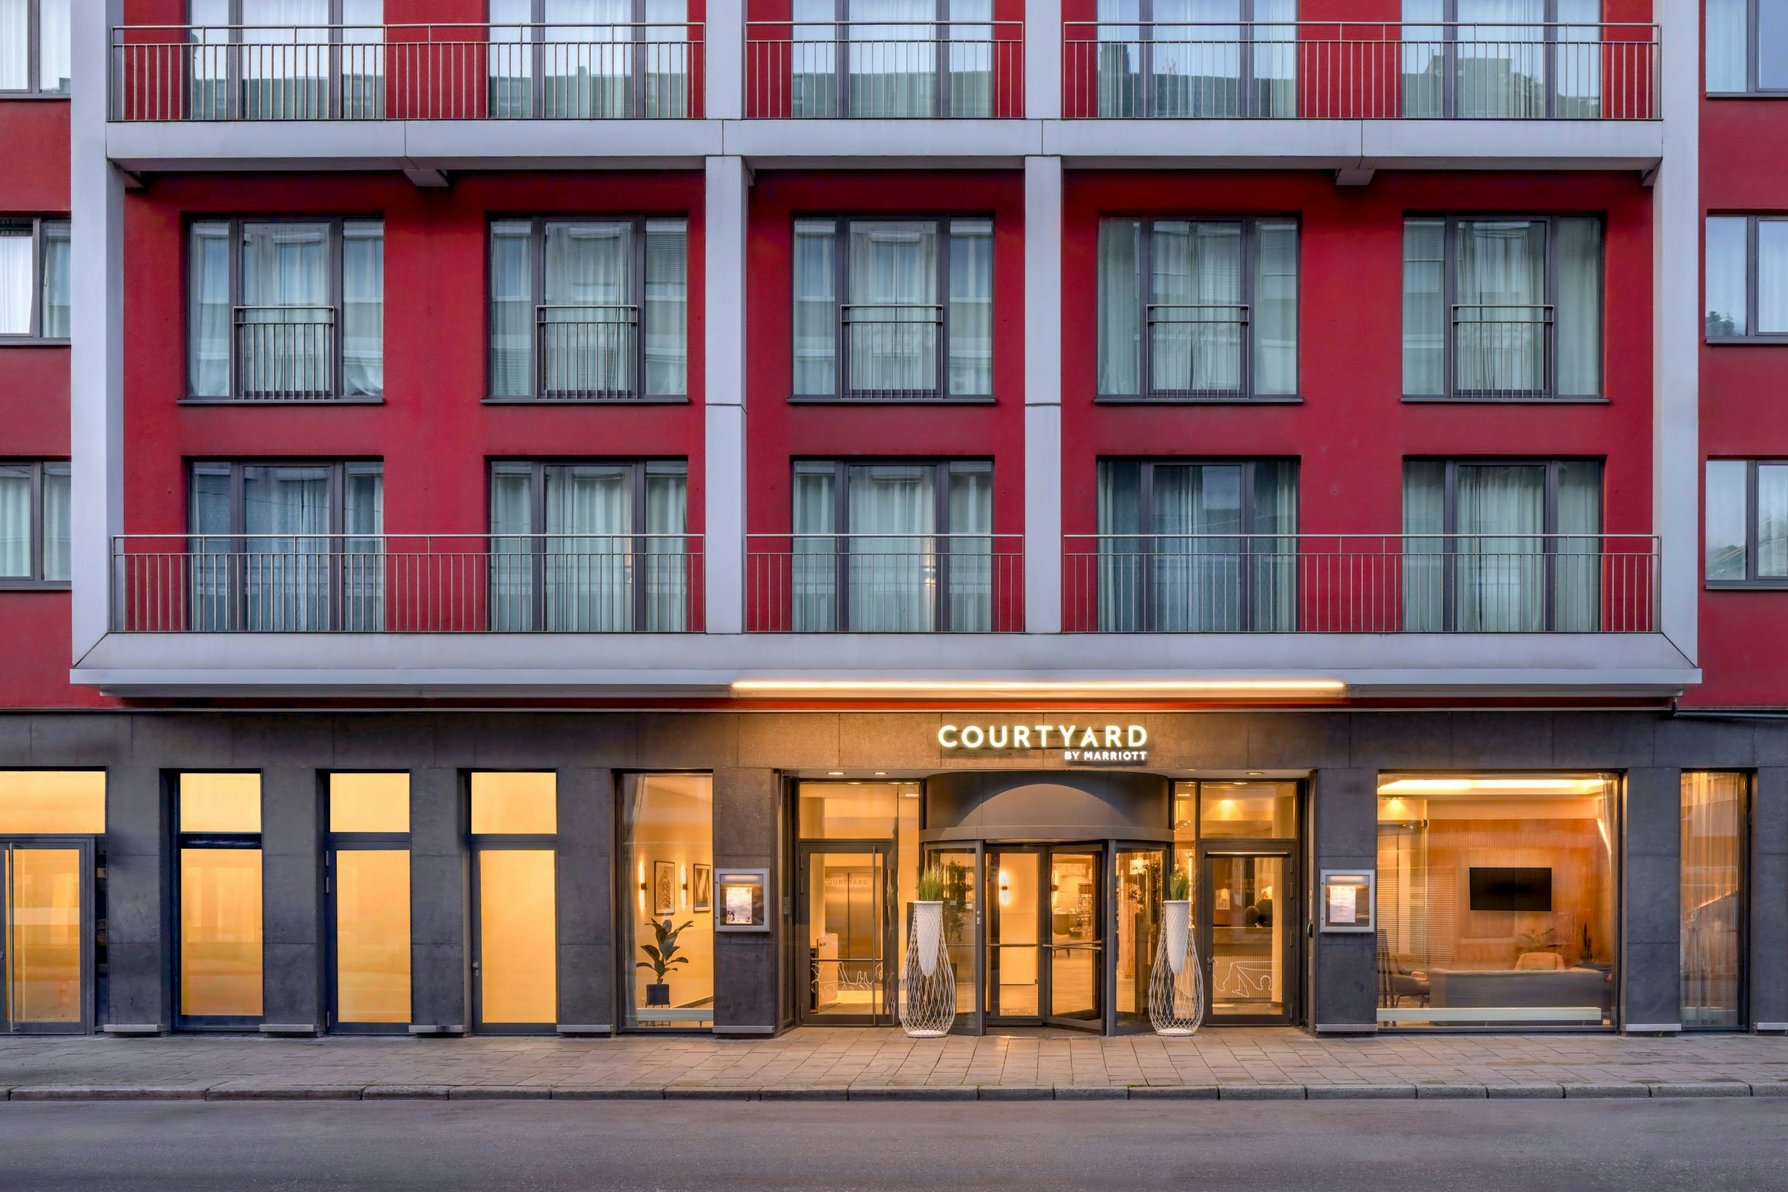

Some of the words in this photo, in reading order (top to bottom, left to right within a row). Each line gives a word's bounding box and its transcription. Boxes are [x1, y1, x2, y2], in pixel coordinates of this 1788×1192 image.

[938, 724, 1148, 748] COURTYARD
[1064, 751, 1080, 760] BY
[1084, 751, 1147, 760] MARRIOTT
